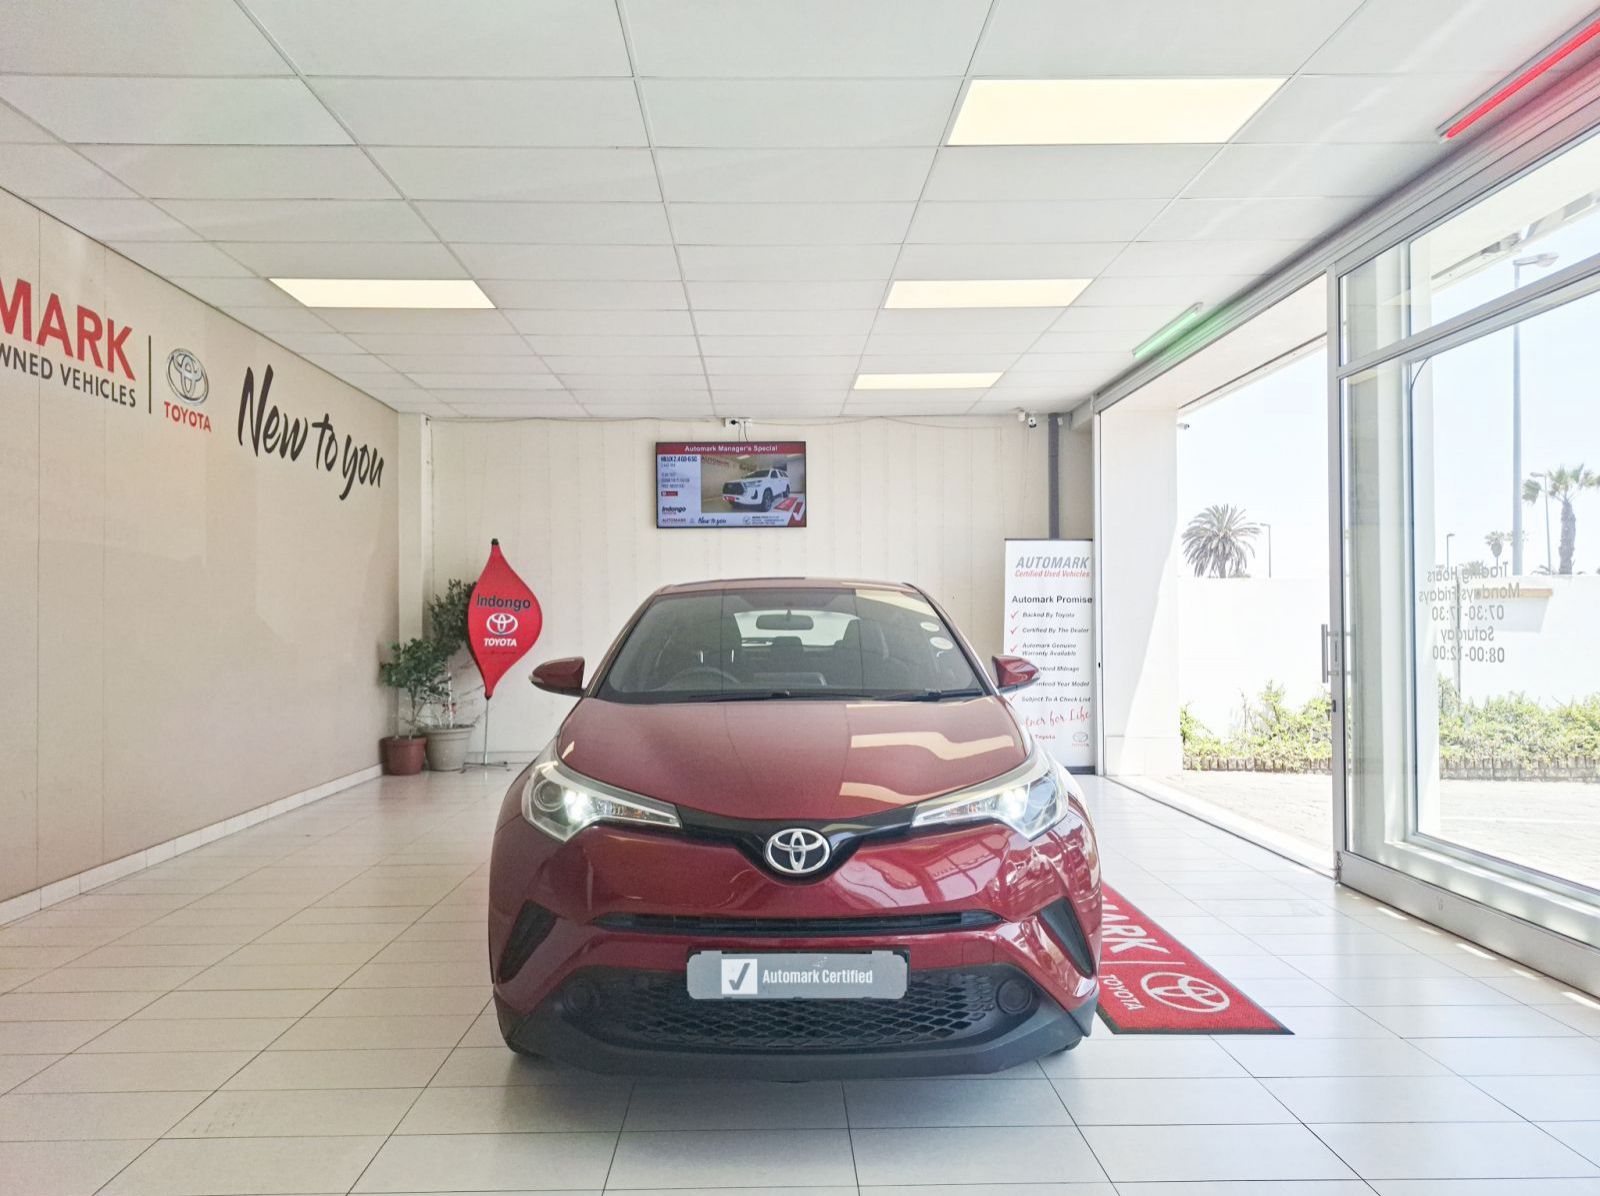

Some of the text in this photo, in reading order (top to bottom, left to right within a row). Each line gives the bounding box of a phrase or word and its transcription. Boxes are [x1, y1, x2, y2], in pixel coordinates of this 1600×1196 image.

[0, 276, 136, 381] MARK
[60, 362, 137, 408] VEHICLES
[164, 401, 212, 432] TOYOTA
[238, 364, 384, 500] New to you
[718, 445, 752, 453] Manager's
[1016, 556, 1089, 569] AUTOMARK
[1015, 570, 1090, 578] Certified Used Vehicles
[476, 593, 531, 612] Indongo
[1011, 595, 1093, 603] Automark Promise
[484, 638, 517, 647] TOYOTA
[762, 969, 873, 984] Automark Certified
[1097, 974, 1146, 1010] TOYOTA
